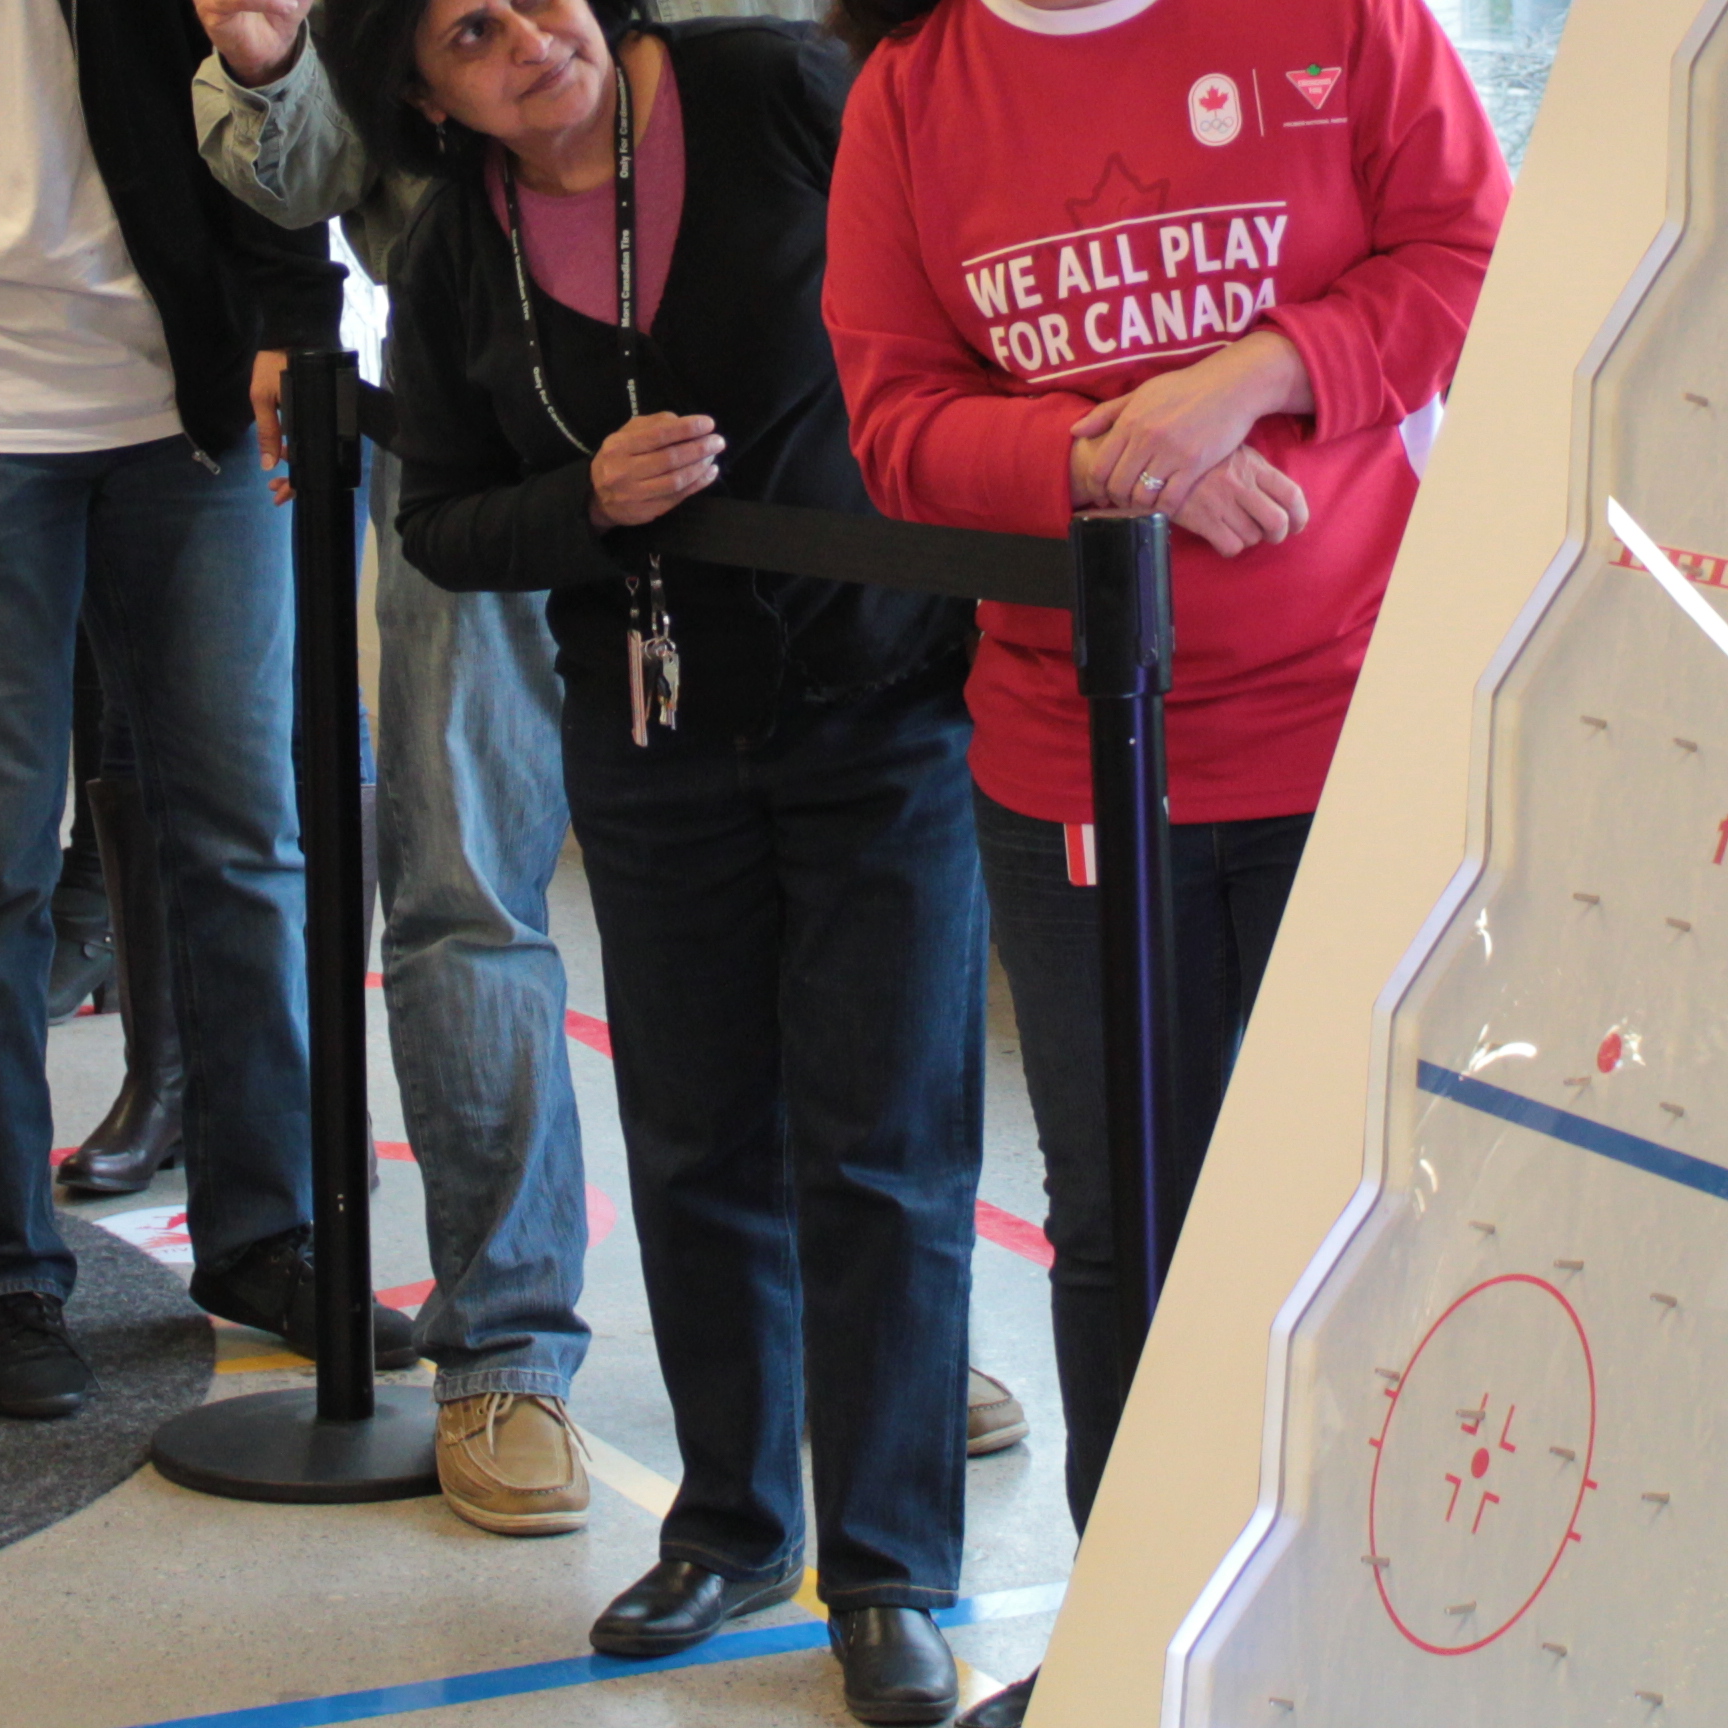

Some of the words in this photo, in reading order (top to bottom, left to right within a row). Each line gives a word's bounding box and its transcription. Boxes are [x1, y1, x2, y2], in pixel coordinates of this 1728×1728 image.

[965, 255, 1043, 319] WE
[1058, 233, 1149, 299] ALL
[1159, 215, 1288, 278] PLAY
[989, 313, 1075, 372] FOR
[1084, 277, 1276, 353] CANADA
